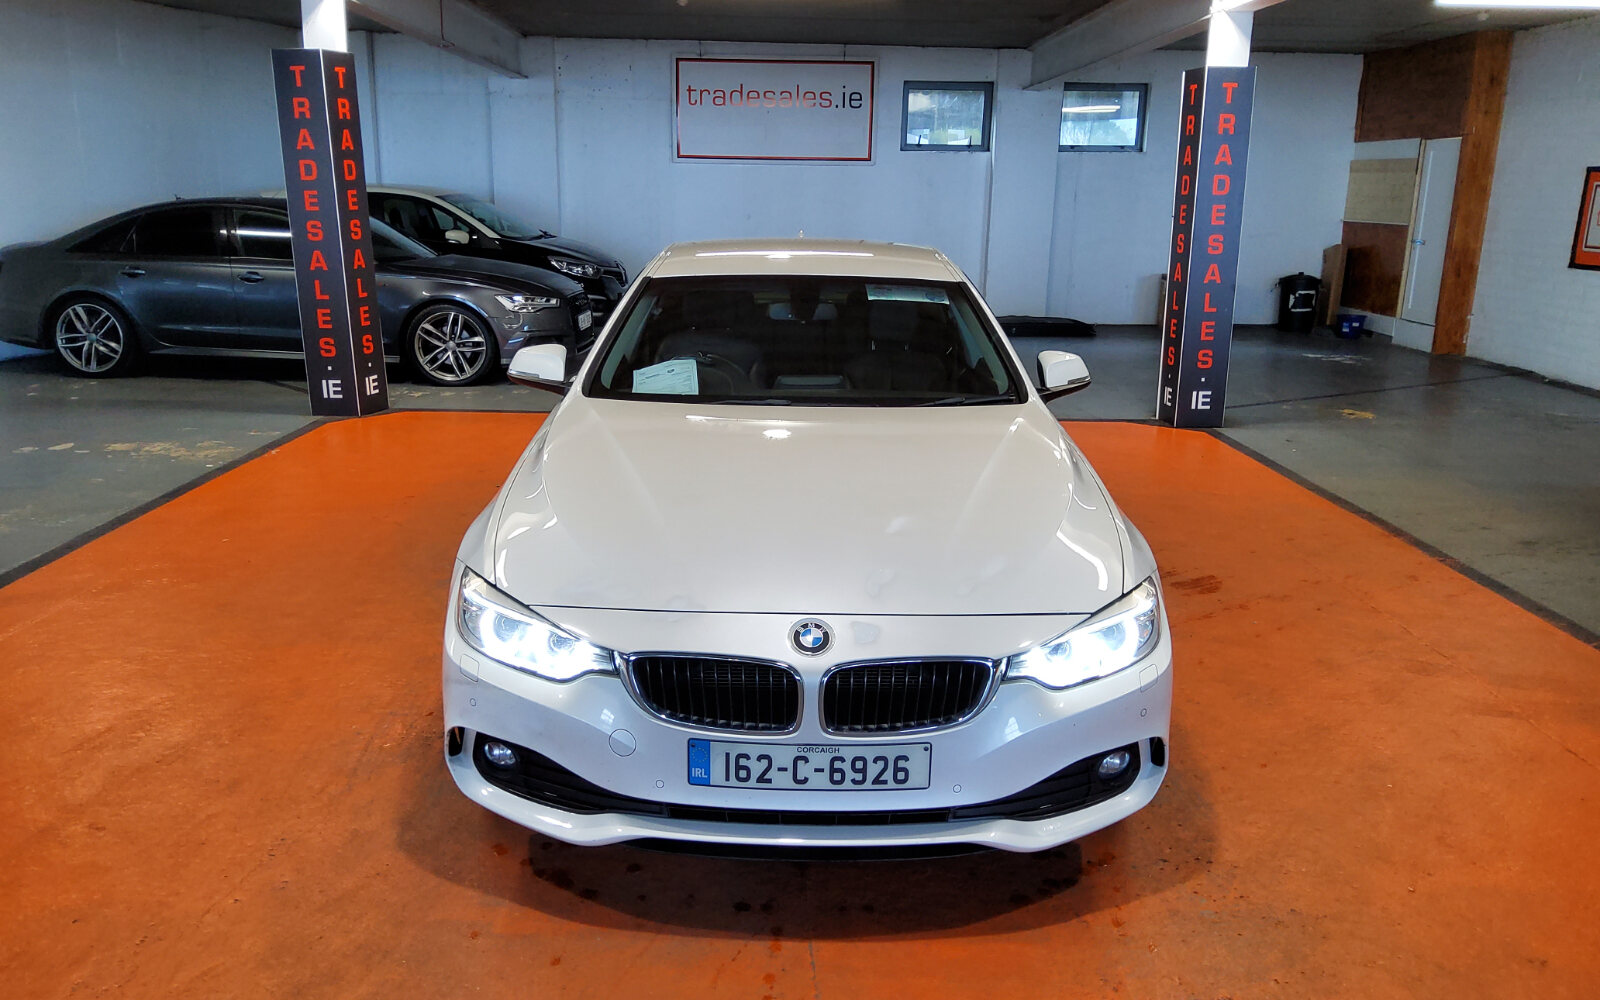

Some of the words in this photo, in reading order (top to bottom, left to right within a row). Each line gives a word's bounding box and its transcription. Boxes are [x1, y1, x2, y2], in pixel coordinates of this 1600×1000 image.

[686, 83, 863, 109] tradesales.ie
[796, 746, 840, 754] CORCAIGH
[691, 768, 708, 778] IRL
[724, 752, 910, 786] 162-C-6926
